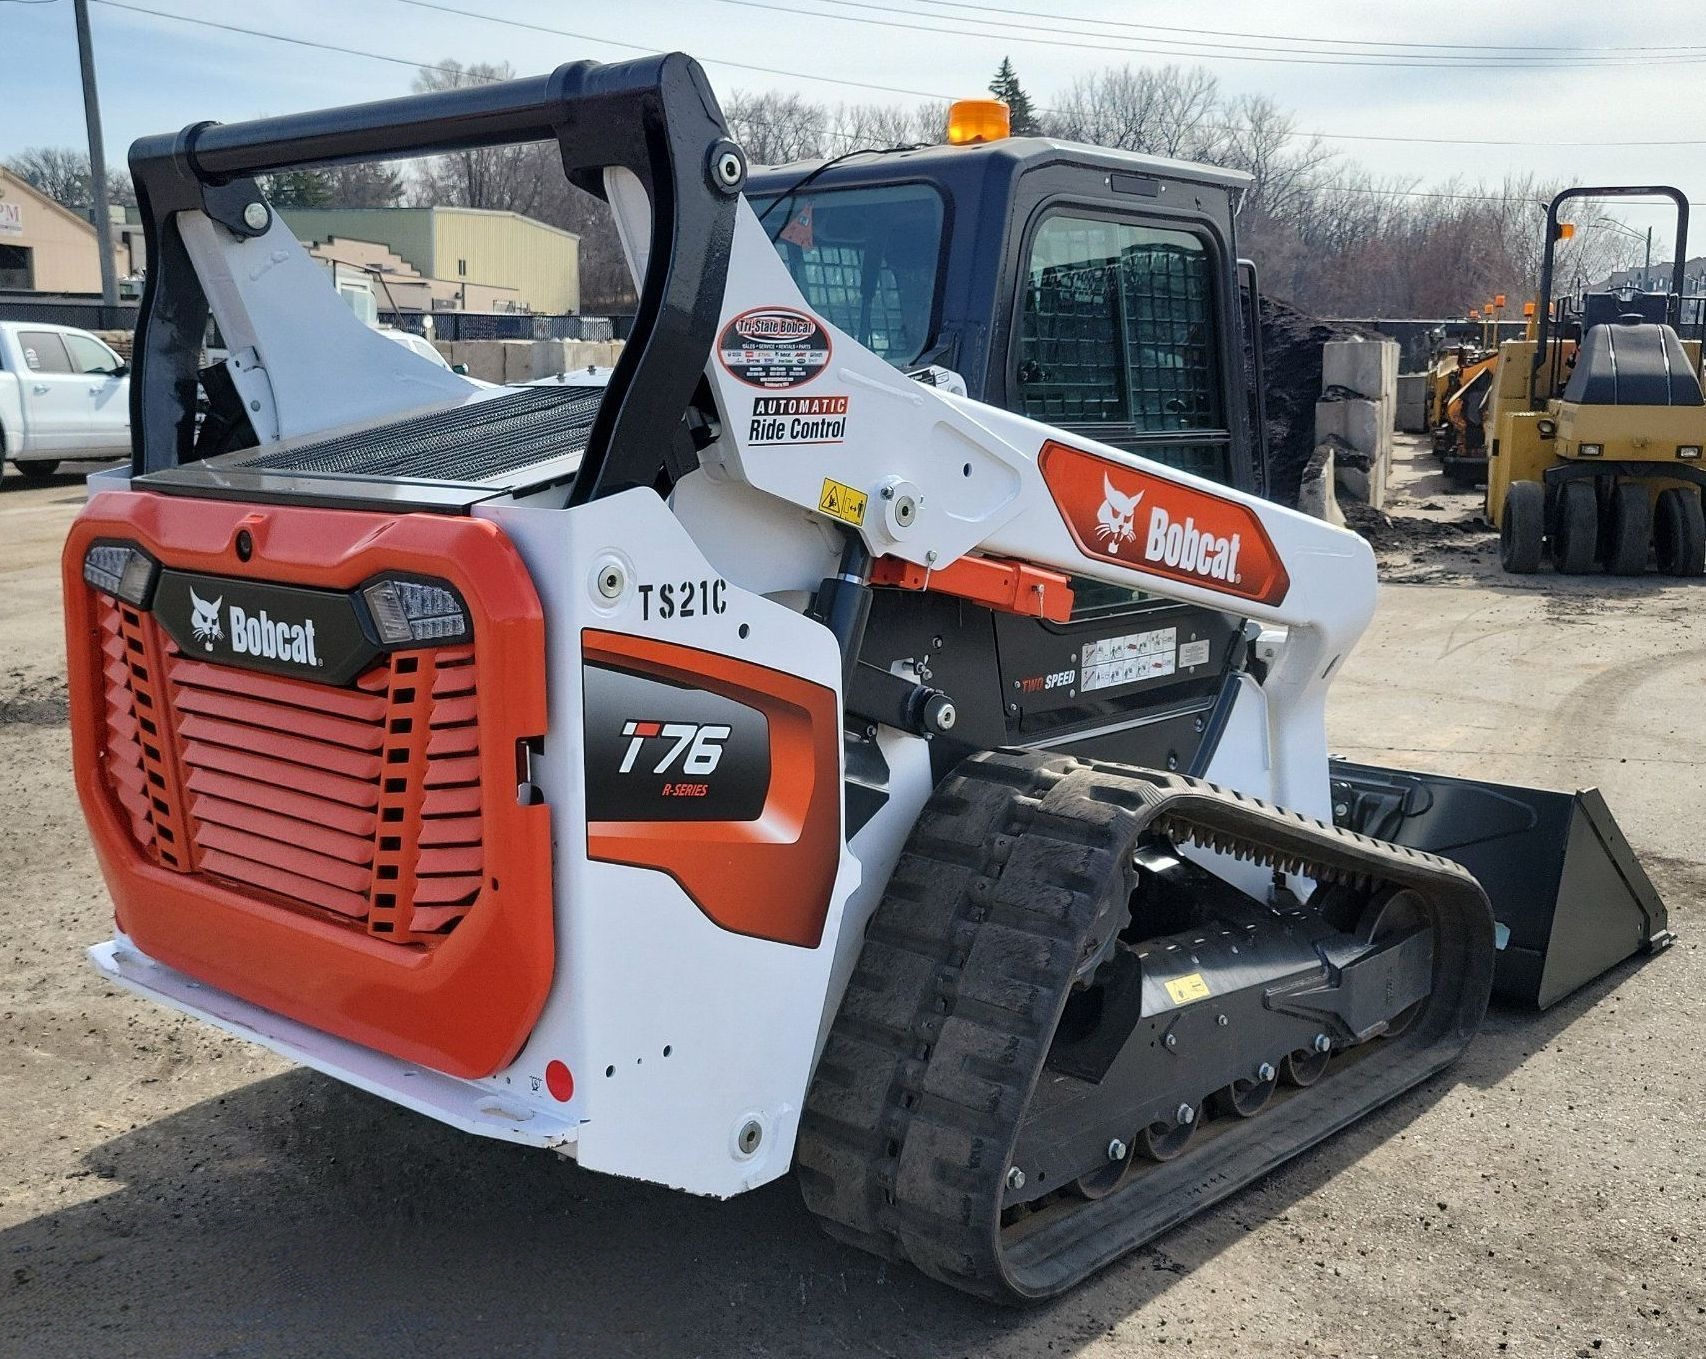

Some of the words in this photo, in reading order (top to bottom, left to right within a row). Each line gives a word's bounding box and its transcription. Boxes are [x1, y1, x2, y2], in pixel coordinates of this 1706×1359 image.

[739, 320, 779, 333] Tri-State
[780, 320, 812, 333] Bobcat
[756, 398, 846, 415] AUTOMATIC
[749, 418, 786, 441] Ride
[790, 416, 847, 440] Control
[1145, 506, 1241, 583] Bobcat
[638, 579, 727, 621] TS21C
[229, 605, 317, 666] Bobcat
[1022, 677, 1044, 693] TWO
[1045, 670, 1076, 690] SPEED
[618, 721, 732, 775] T76
[662, 783, 709, 797] R-SERIES
